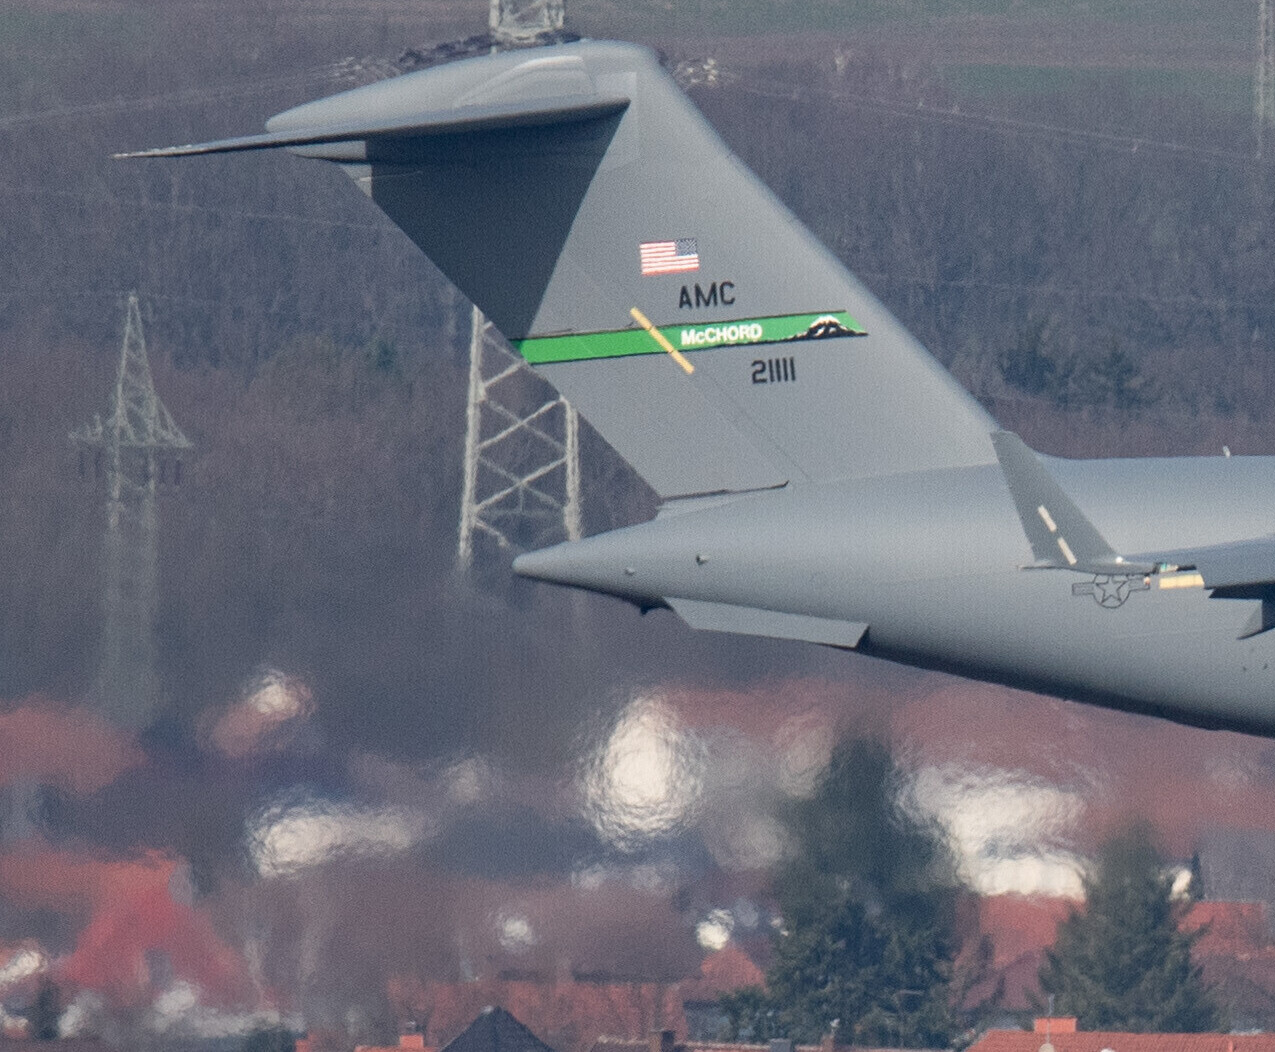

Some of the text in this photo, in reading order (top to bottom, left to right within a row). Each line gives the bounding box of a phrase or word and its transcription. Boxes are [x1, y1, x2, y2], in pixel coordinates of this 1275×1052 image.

[679, 281, 736, 308] AMC
[681, 323, 762, 346] McCHORD
[751, 357, 796, 384] 21111
